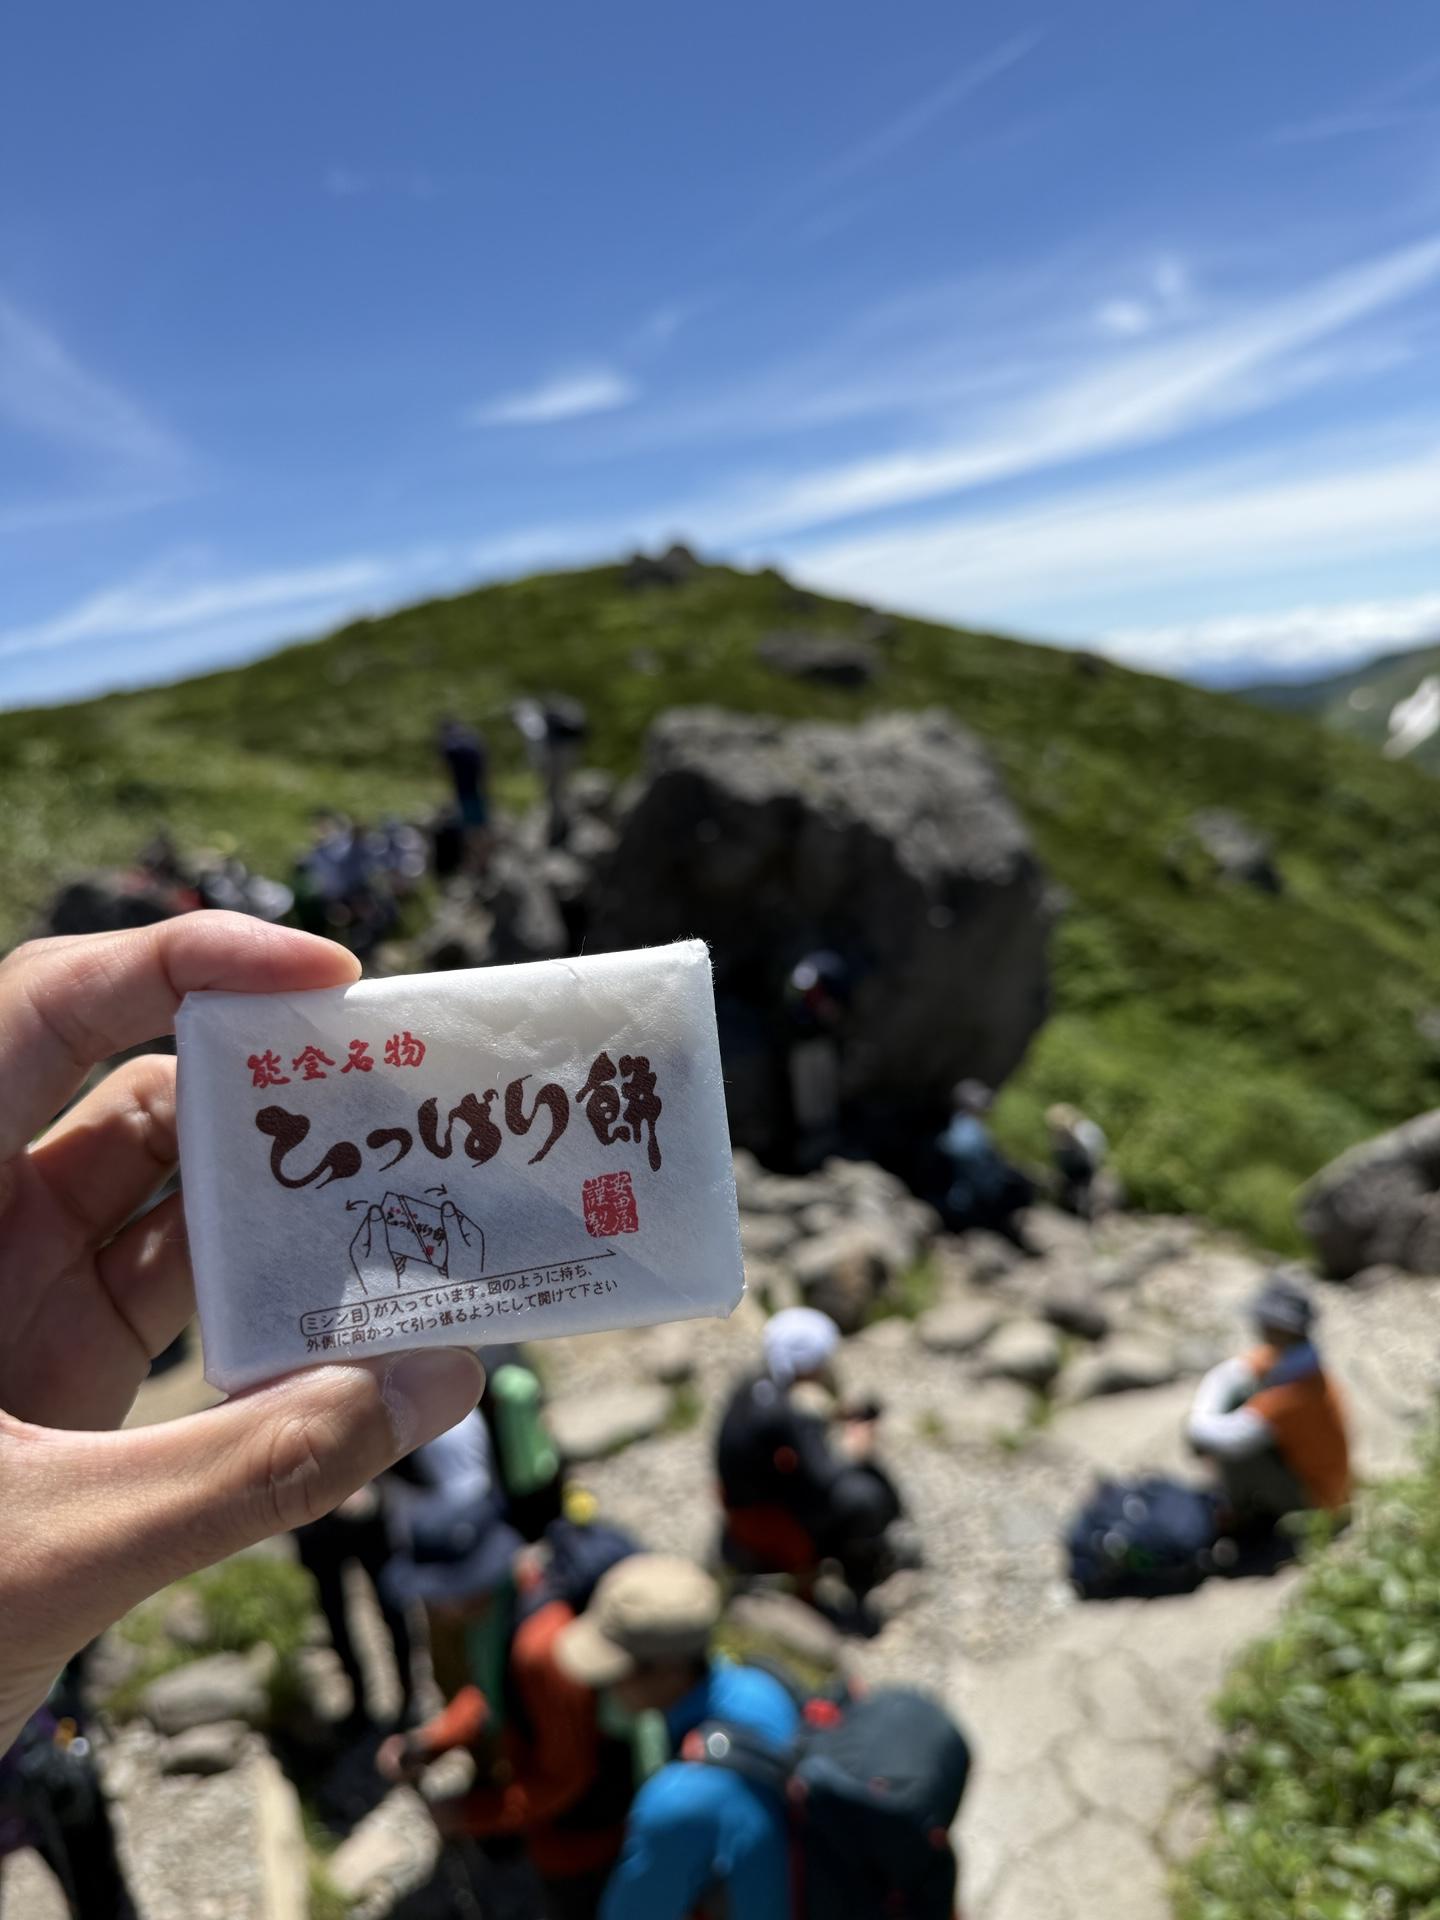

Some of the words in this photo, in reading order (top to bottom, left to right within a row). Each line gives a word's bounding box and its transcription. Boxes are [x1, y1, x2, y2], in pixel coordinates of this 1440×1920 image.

[247, 1031, 427, 1088] 能登名物
[306, 1279, 618, 1353] 外側に向かって引っ張るようにして開けて下さい
[306, 1308, 363, 1330] ミシン目
